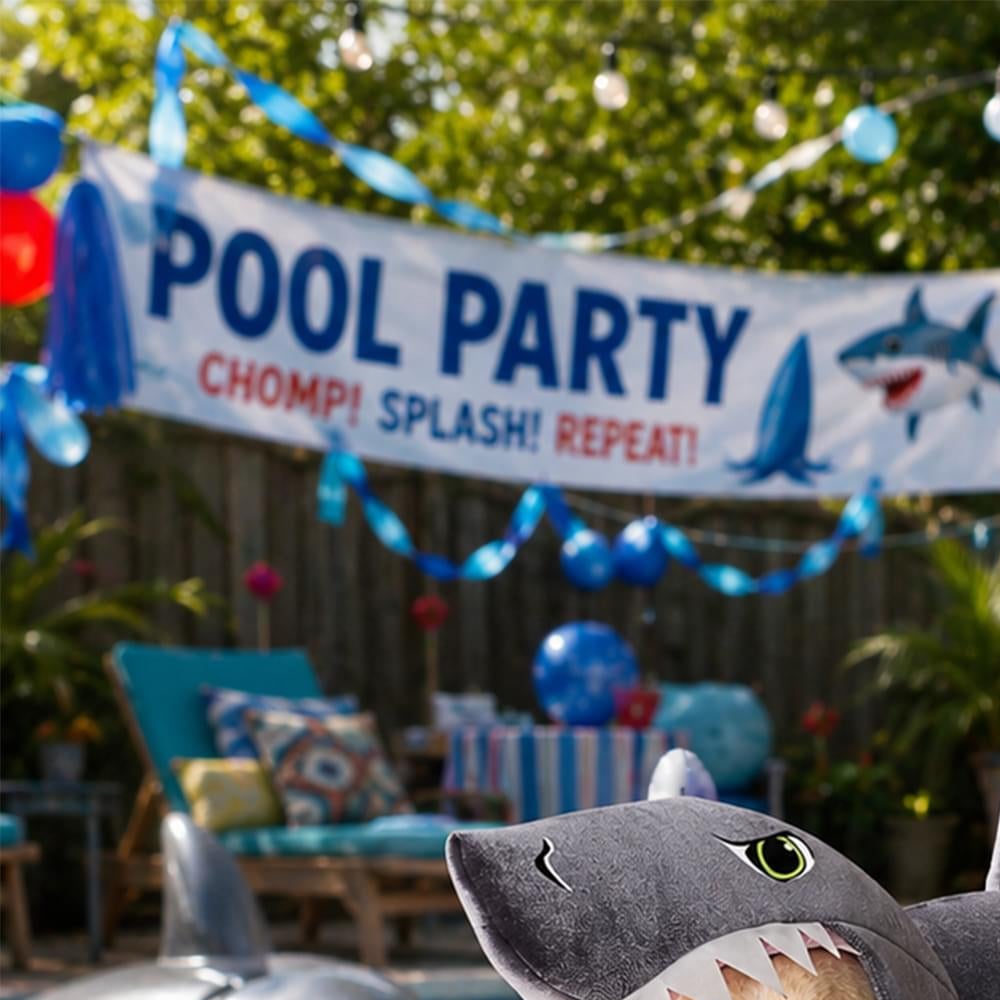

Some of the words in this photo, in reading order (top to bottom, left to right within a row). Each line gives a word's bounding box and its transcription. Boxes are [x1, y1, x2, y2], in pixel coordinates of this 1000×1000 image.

[148, 205, 399, 366] POOL
[440, 269, 750, 406] PARTY
[198, 350, 363, 427] CHOMP!
[378, 389, 542, 453] SPLASH!
[554, 412, 699, 466] REPEAT!
